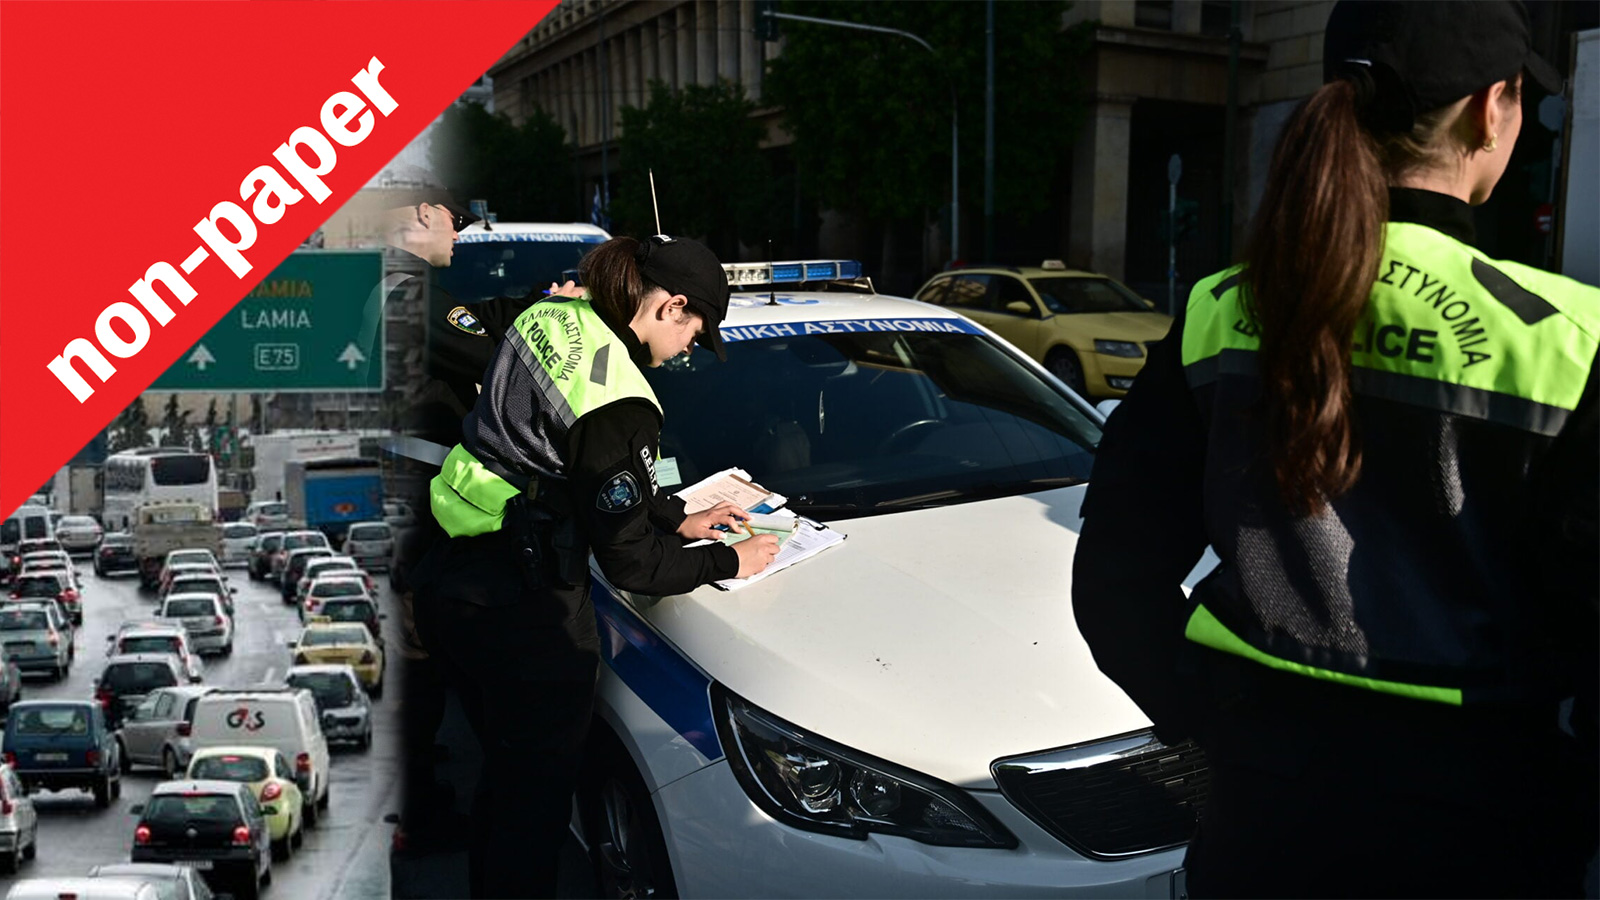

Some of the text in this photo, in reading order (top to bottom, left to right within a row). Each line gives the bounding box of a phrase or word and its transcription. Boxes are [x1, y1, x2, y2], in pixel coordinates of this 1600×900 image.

[488, 233, 584, 243] ΑΣΤΥΝΟΜΙΑ
[241, 309, 312, 329] LAMIA
[719, 319, 966, 342] ΝΙΚΗ ΑΣΤΥΝΟΜΙΑ
[1380, 260, 1492, 369] ΣΤΥΝΟΜΙΑ
[259, 348, 294, 365] E75
[526, 321, 563, 370] POLICE
[557, 321, 584, 381] ΑΣΤΥΝΟΜΙΑ
[1353, 321, 1438, 364] ICE
